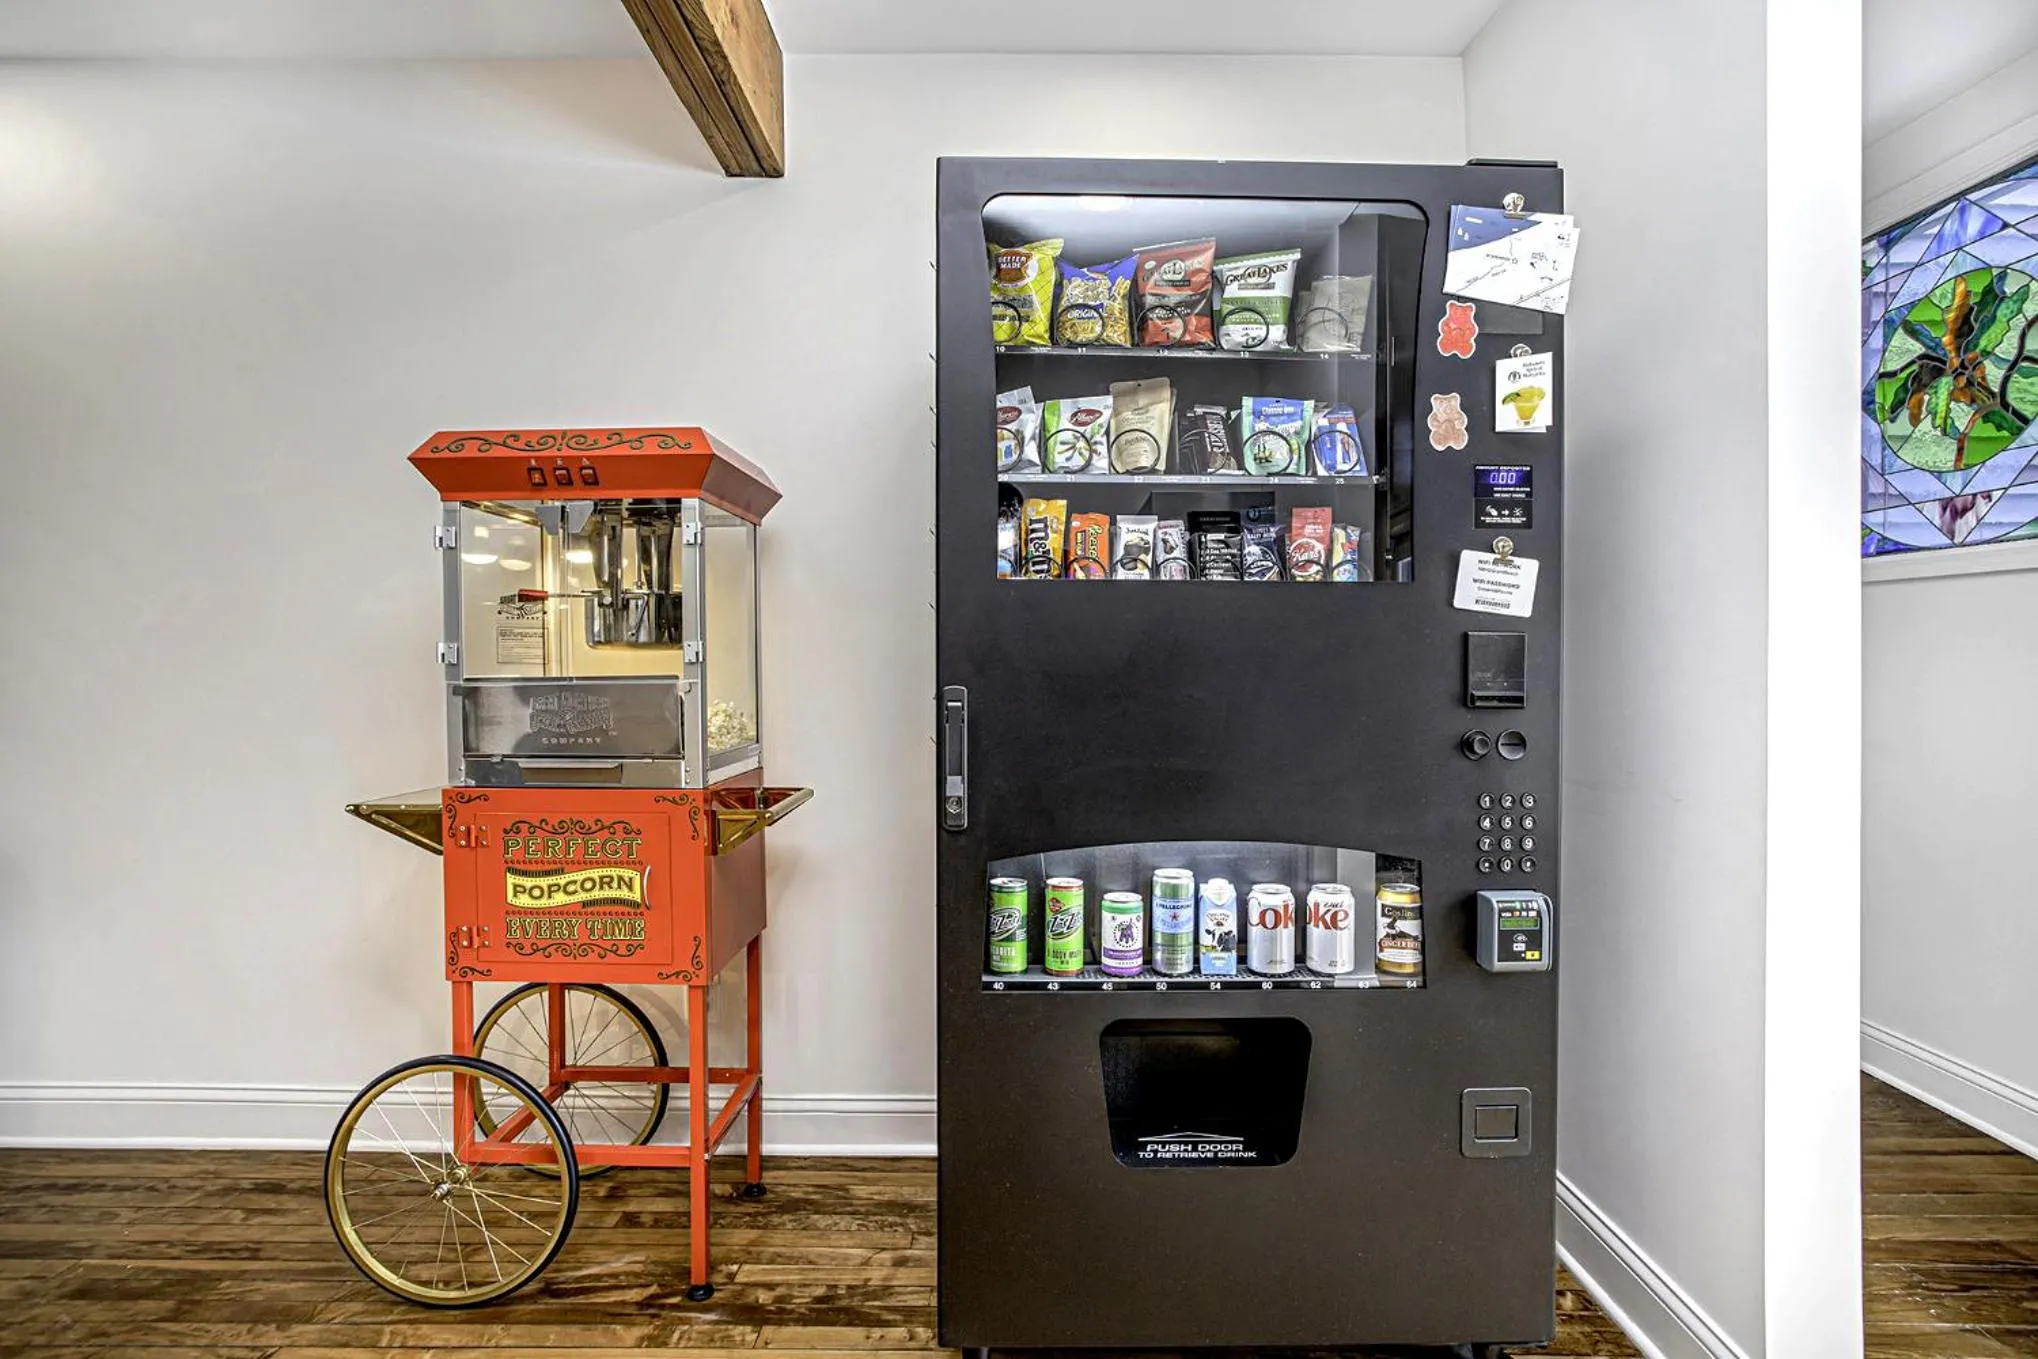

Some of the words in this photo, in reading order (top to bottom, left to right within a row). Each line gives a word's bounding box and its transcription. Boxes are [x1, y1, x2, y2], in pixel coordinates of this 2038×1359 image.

[1484, 796, 1490, 807] 1
[1506, 796, 1513, 807] 2
[1527, 796, 1534, 807] 3
[1484, 818, 1490, 828] 4
[1505, 818, 1512, 827] 5
[1526, 817, 1532, 828] 6
[503, 836, 642, 859] PERFECT
[1484, 839, 1490, 850] 7
[1505, 839, 1512, 849] 8
[1526, 838, 1532, 849] 9
[1505, 860, 1511, 870] 0
[511, 874, 635, 900] POPCORN
[1248, 897, 1294, 930] Cok
[506, 917, 582, 940] EVERY
[586, 917, 645, 940] TIME
[993, 982, 1004, 990] 40
[1047, 982, 1059, 990] 43
[1210, 982, 1221, 990] 54
[1146, 1143, 1192, 1152] PUSH
[1198, 1143, 1243, 1151] DOOR
[1138, 1151, 1154, 1159] TO
[1157, 1151, 1214, 1159] RETRIEVE
[1218, 1150, 1257, 1158] DRINK
